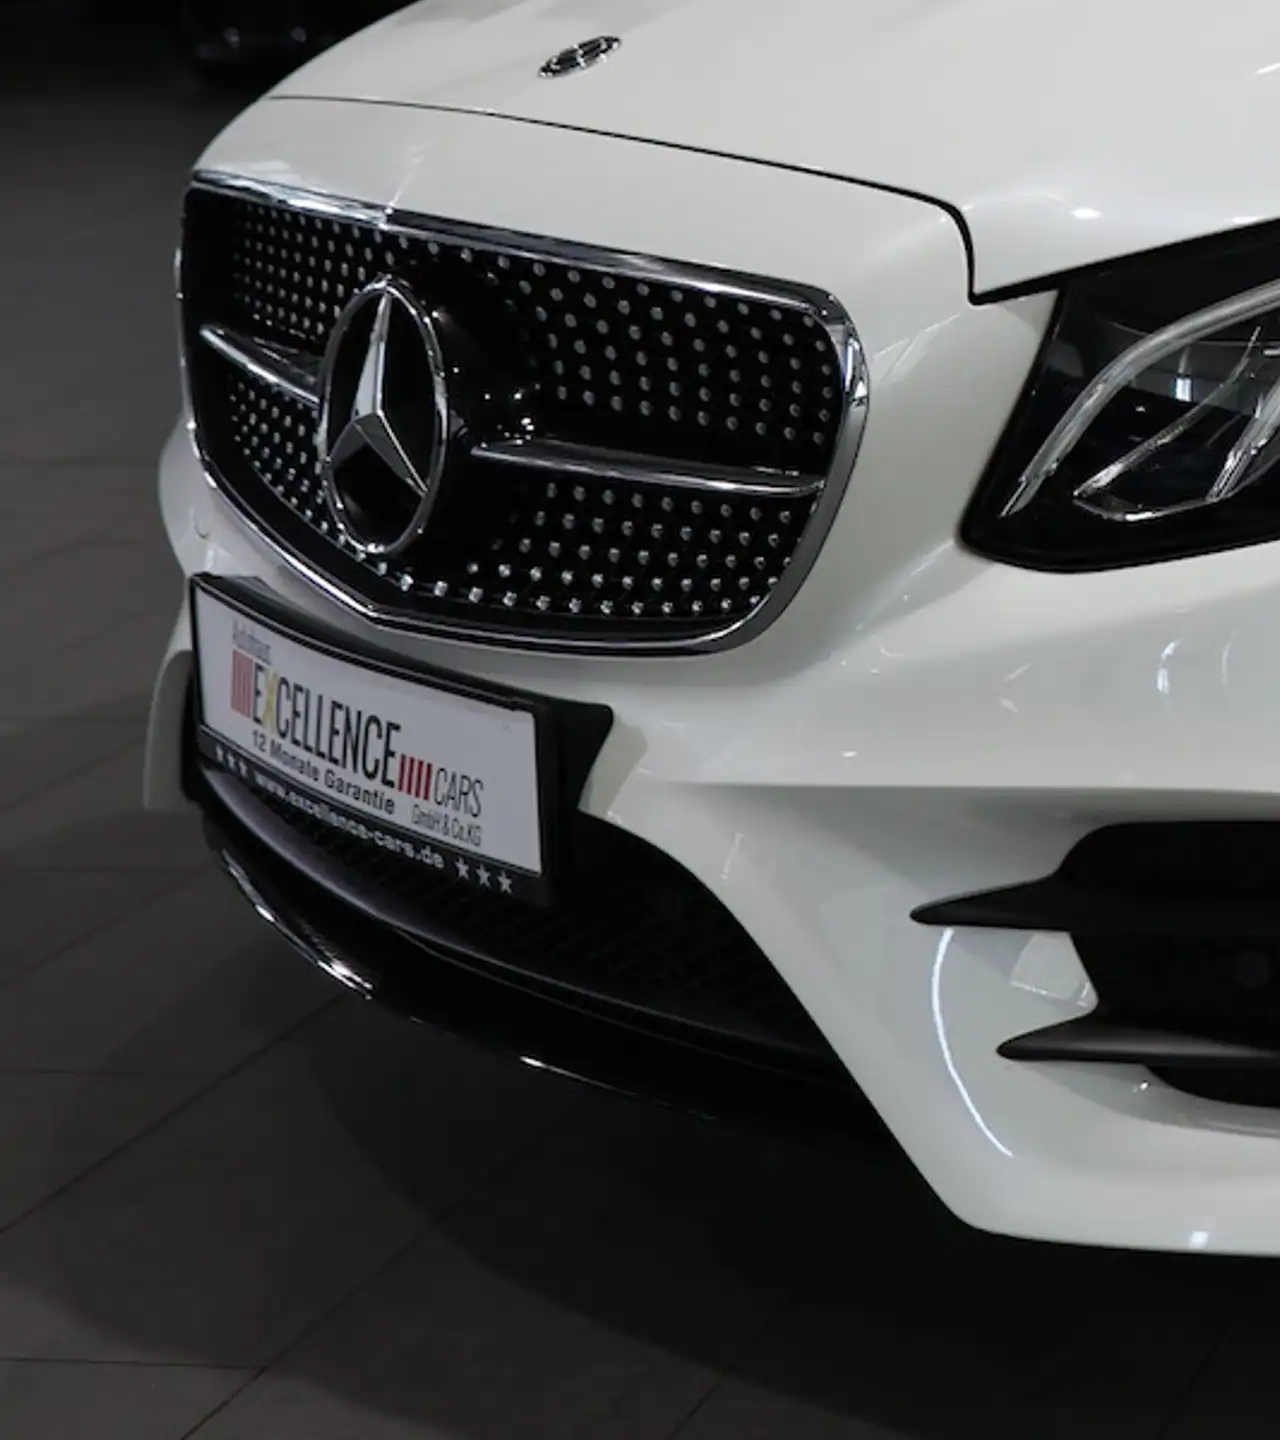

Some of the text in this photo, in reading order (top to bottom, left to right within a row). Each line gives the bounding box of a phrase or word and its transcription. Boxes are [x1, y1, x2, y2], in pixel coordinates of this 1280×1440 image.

[252, 729, 396, 815] 12 Monate Garantie
[253, 662, 484, 819] EXCELLENCE CARS
[411, 803, 441, 833] GmbH
